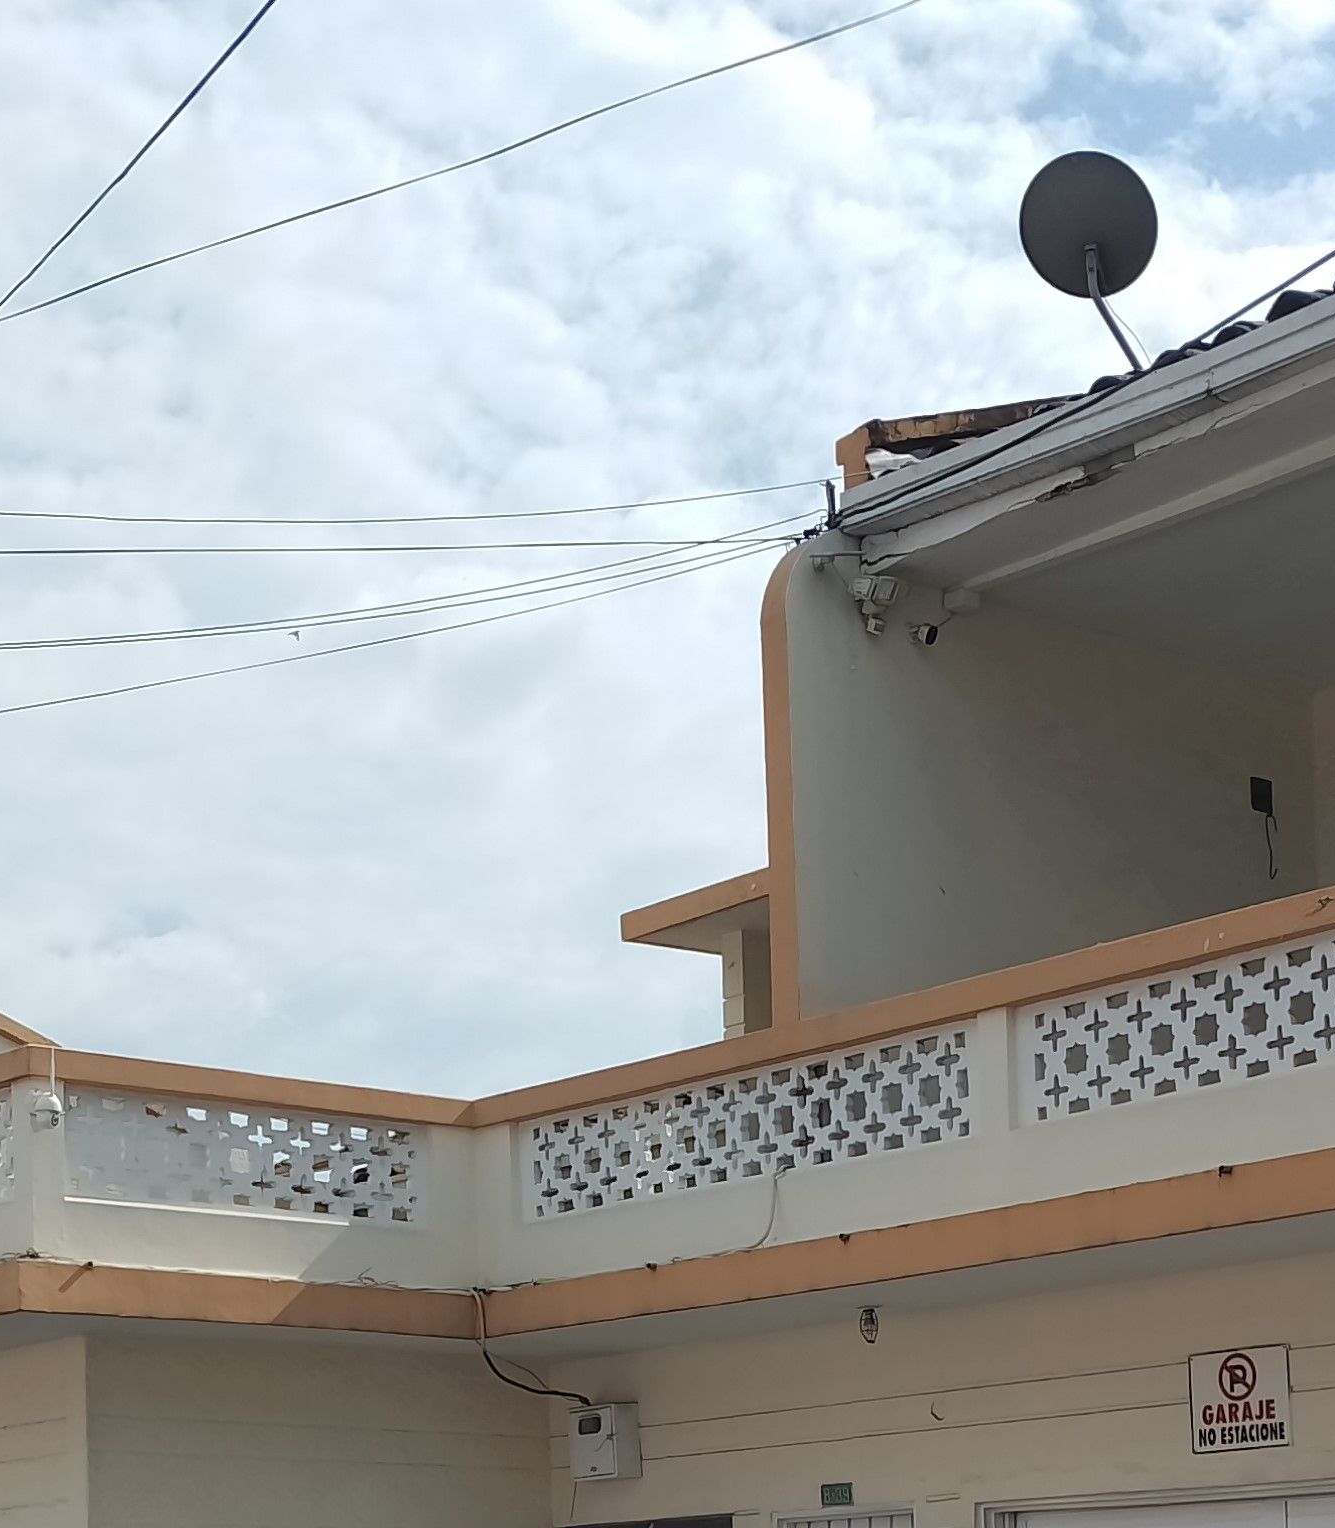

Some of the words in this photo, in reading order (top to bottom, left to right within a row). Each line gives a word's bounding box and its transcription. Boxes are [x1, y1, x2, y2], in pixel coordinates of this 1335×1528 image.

[1202, 1399, 1276, 1425] GARAJE
[1198, 1428, 1216, 1447] NO
[1220, 1422, 1286, 1445] ESTACIONE
